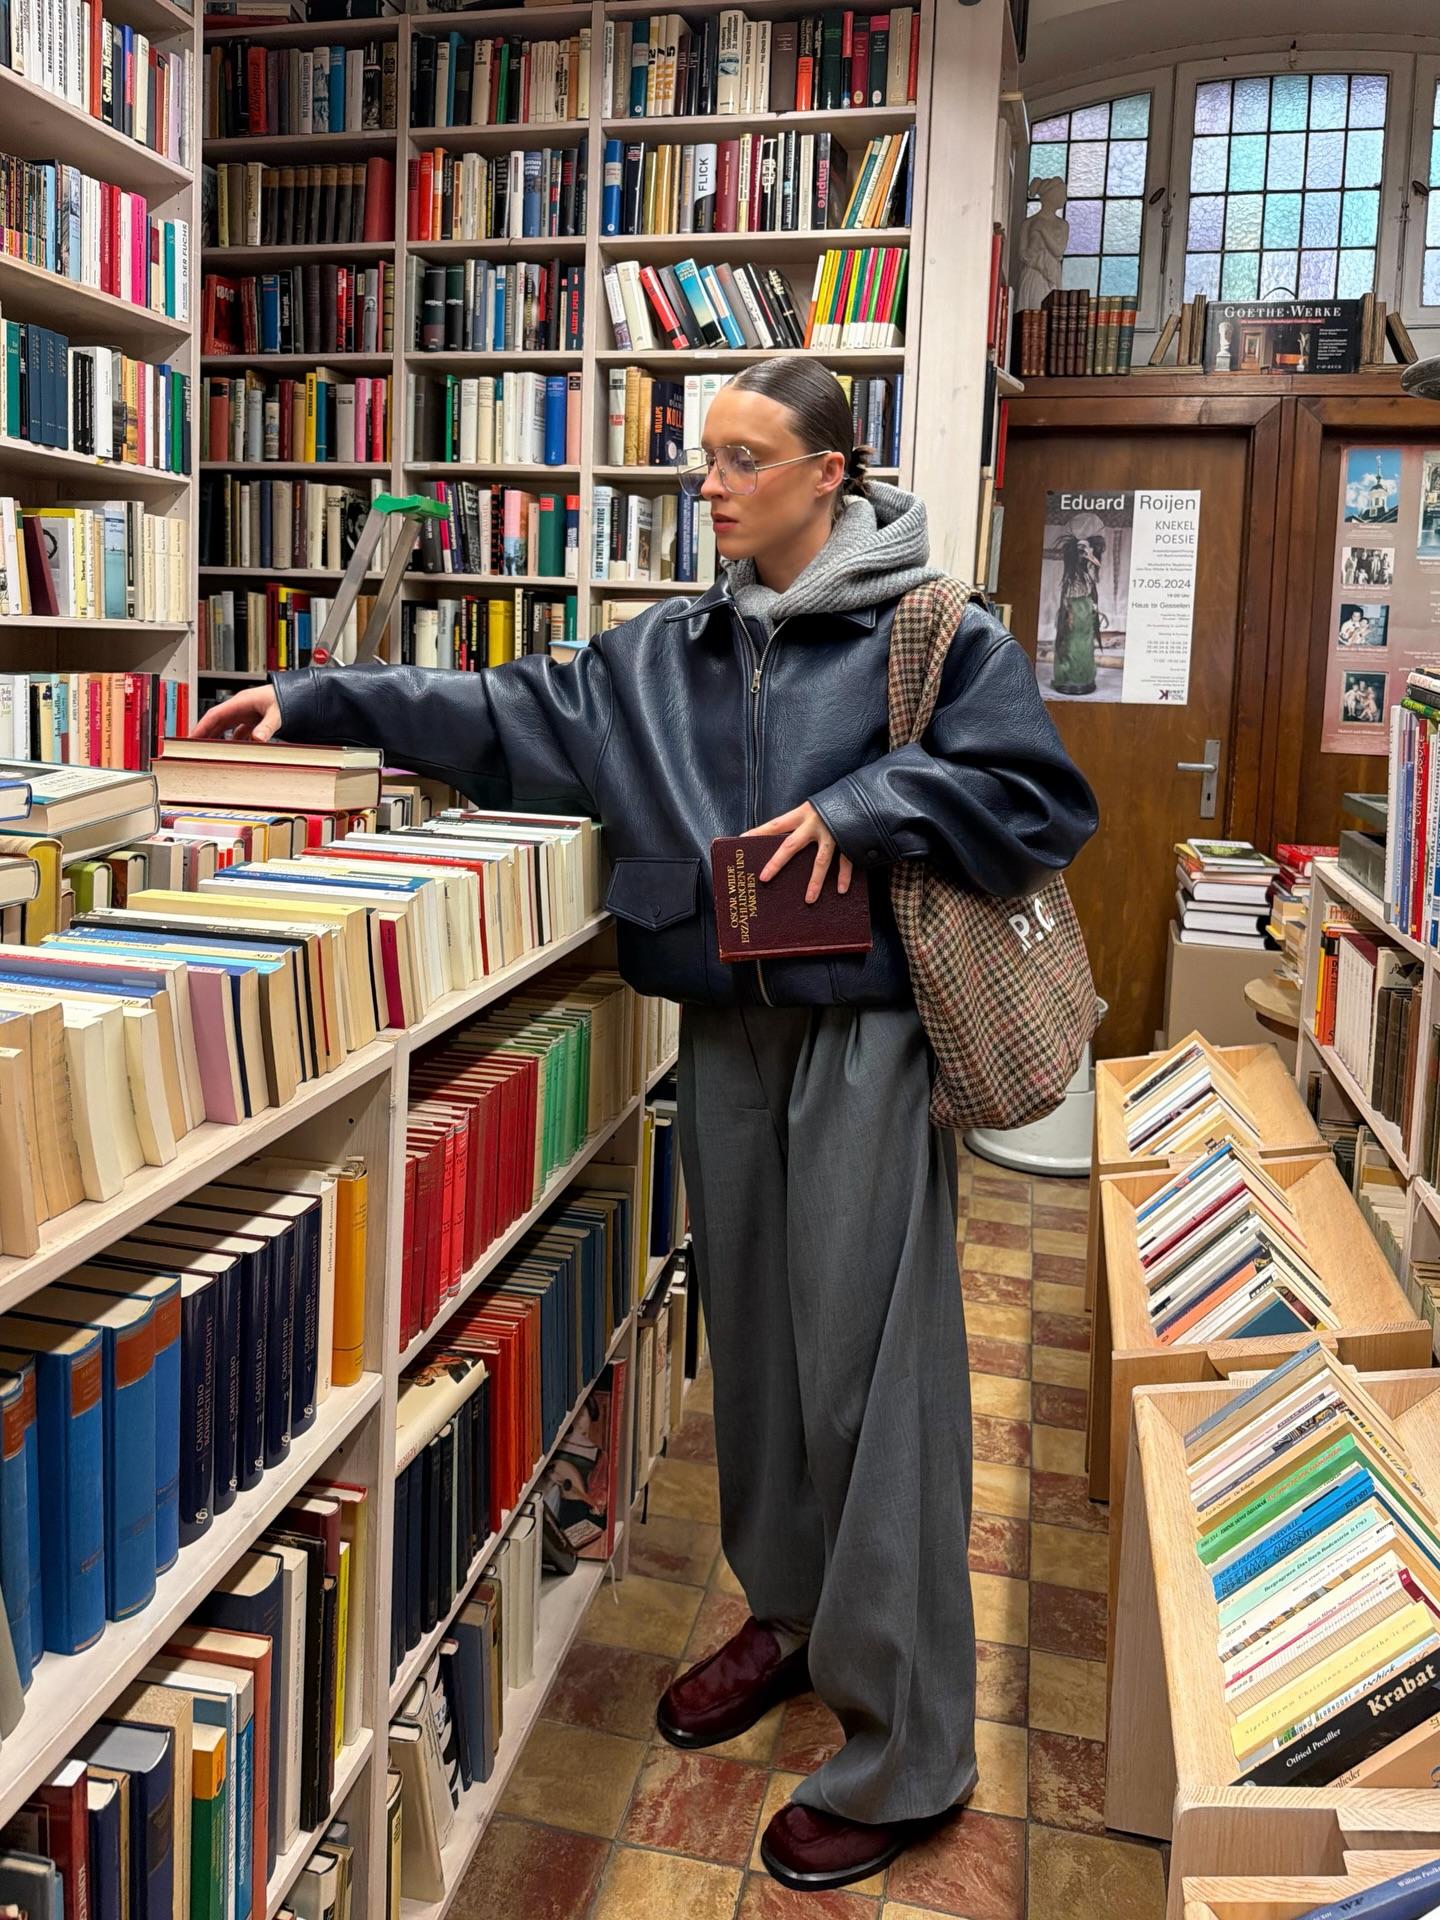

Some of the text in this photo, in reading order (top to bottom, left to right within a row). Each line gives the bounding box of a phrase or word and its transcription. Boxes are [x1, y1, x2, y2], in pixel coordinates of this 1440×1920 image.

[657, 47, 665, 56] 7
[663, 46, 676, 100] FALL 5
[698, 158, 709, 192] FLICK
[817, 160, 828, 208] Empire
[655, 406, 663, 433] KOLLAPS
[1060, 494, 1196, 514] Eduard Roijen
[595, 507, 605, 572] DER ZWEITE WELTKRIEG
[1155, 520, 1195, 531] KNEKEL
[1155, 534, 1195, 544] POESIE
[1132, 579, 1191, 589] 17.05.2024
[736, 849, 744, 869] UND
[1429, 816, 1437, 864] MÄLZER
[727, 865, 738, 928] OSCAR WILDE
[280, 1316, 289, 1379] CASSIUS DIO
[303, 1313, 311, 1353] CASSIUS
[228, 1355, 237, 1421] CASSIUS DIO
[254, 1337, 263, 1402] CASSIUS DIO
[195, 1383, 205, 1451] CASSIUS DIO
[1271, 1526, 1314, 1559] VISCONTI
[1283, 1659, 1440, 1768] Otfried Preußler Krabat
[1398, 1872, 1421, 1888] William
